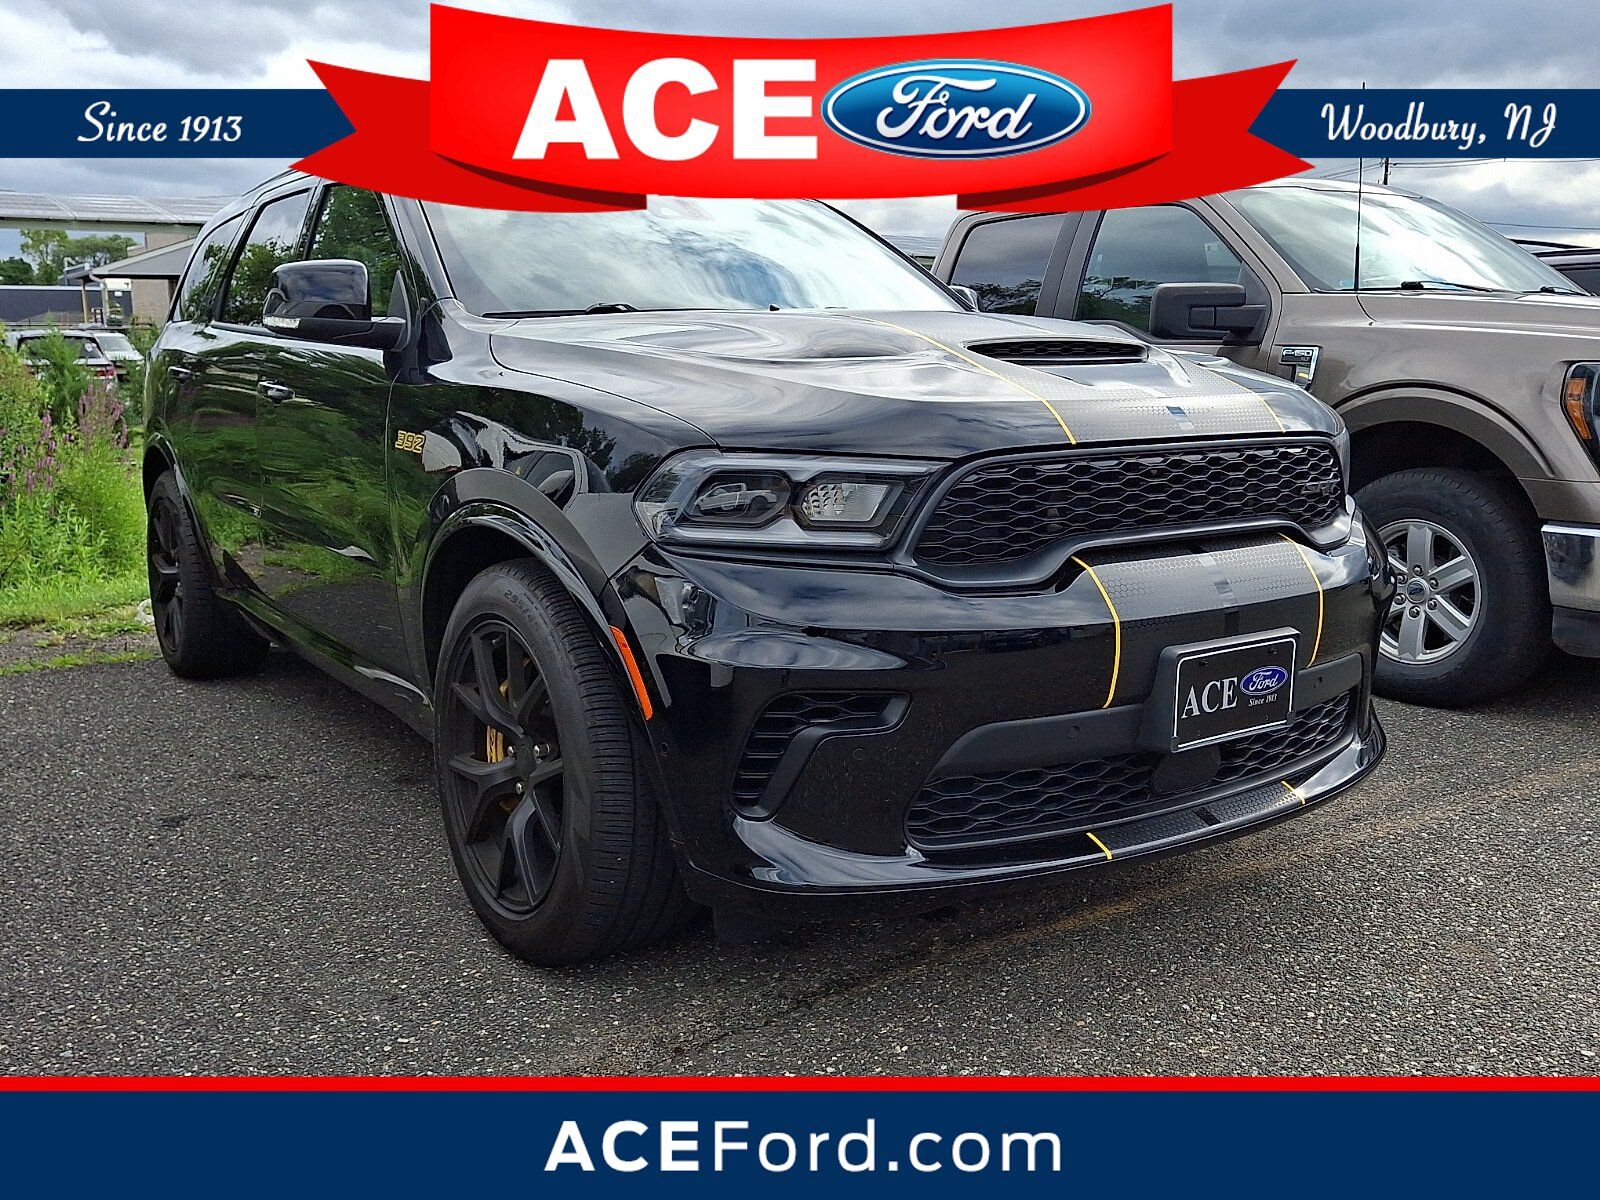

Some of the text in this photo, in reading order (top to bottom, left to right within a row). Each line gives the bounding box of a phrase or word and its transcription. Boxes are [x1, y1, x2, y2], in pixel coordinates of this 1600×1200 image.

[394, 430, 426, 454] 392
[1181, 671, 1279, 719] ACE Ford
[1248, 698, 1265, 707] Since
